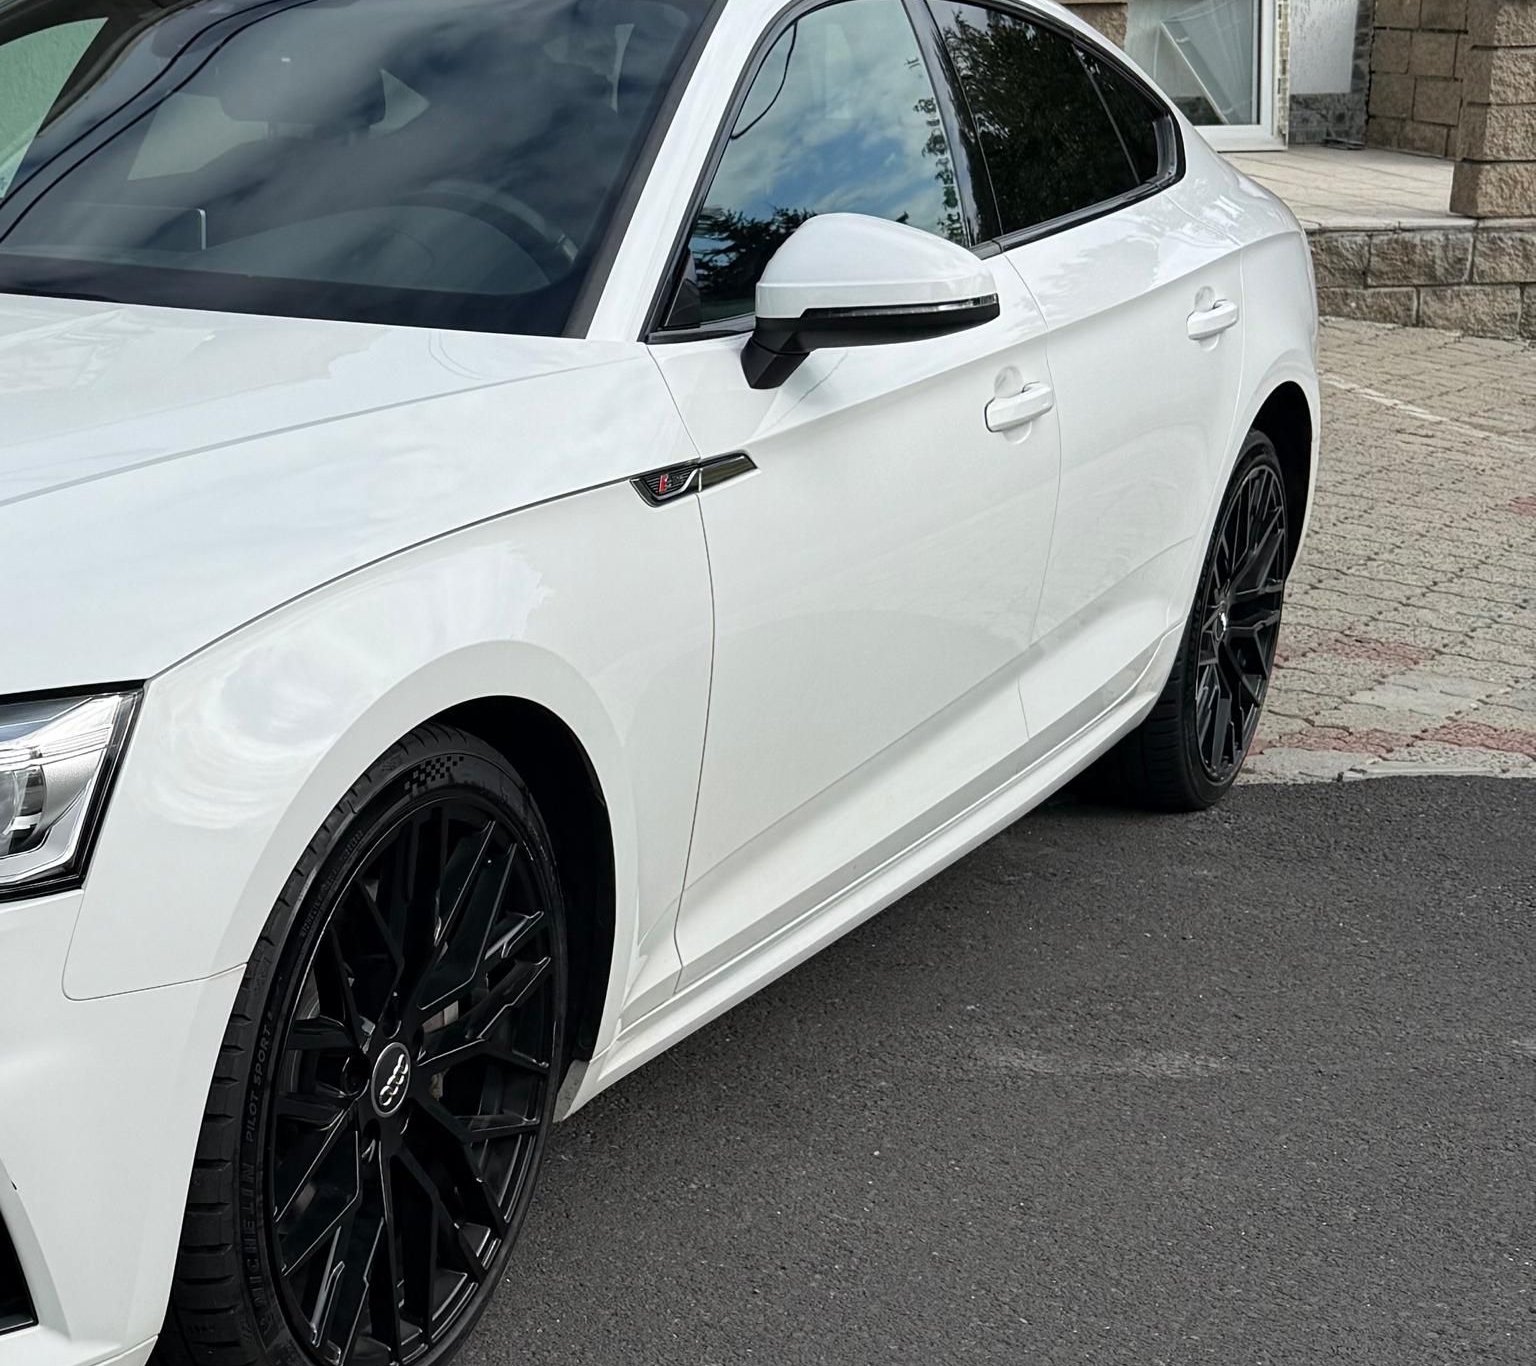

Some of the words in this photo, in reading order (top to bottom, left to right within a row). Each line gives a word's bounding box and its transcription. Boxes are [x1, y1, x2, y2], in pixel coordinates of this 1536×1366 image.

[253, 1023, 272, 1087] SPORT
[246, 1089, 260, 1144] PILOT
[240, 1161, 268, 1309] MICHELIN
